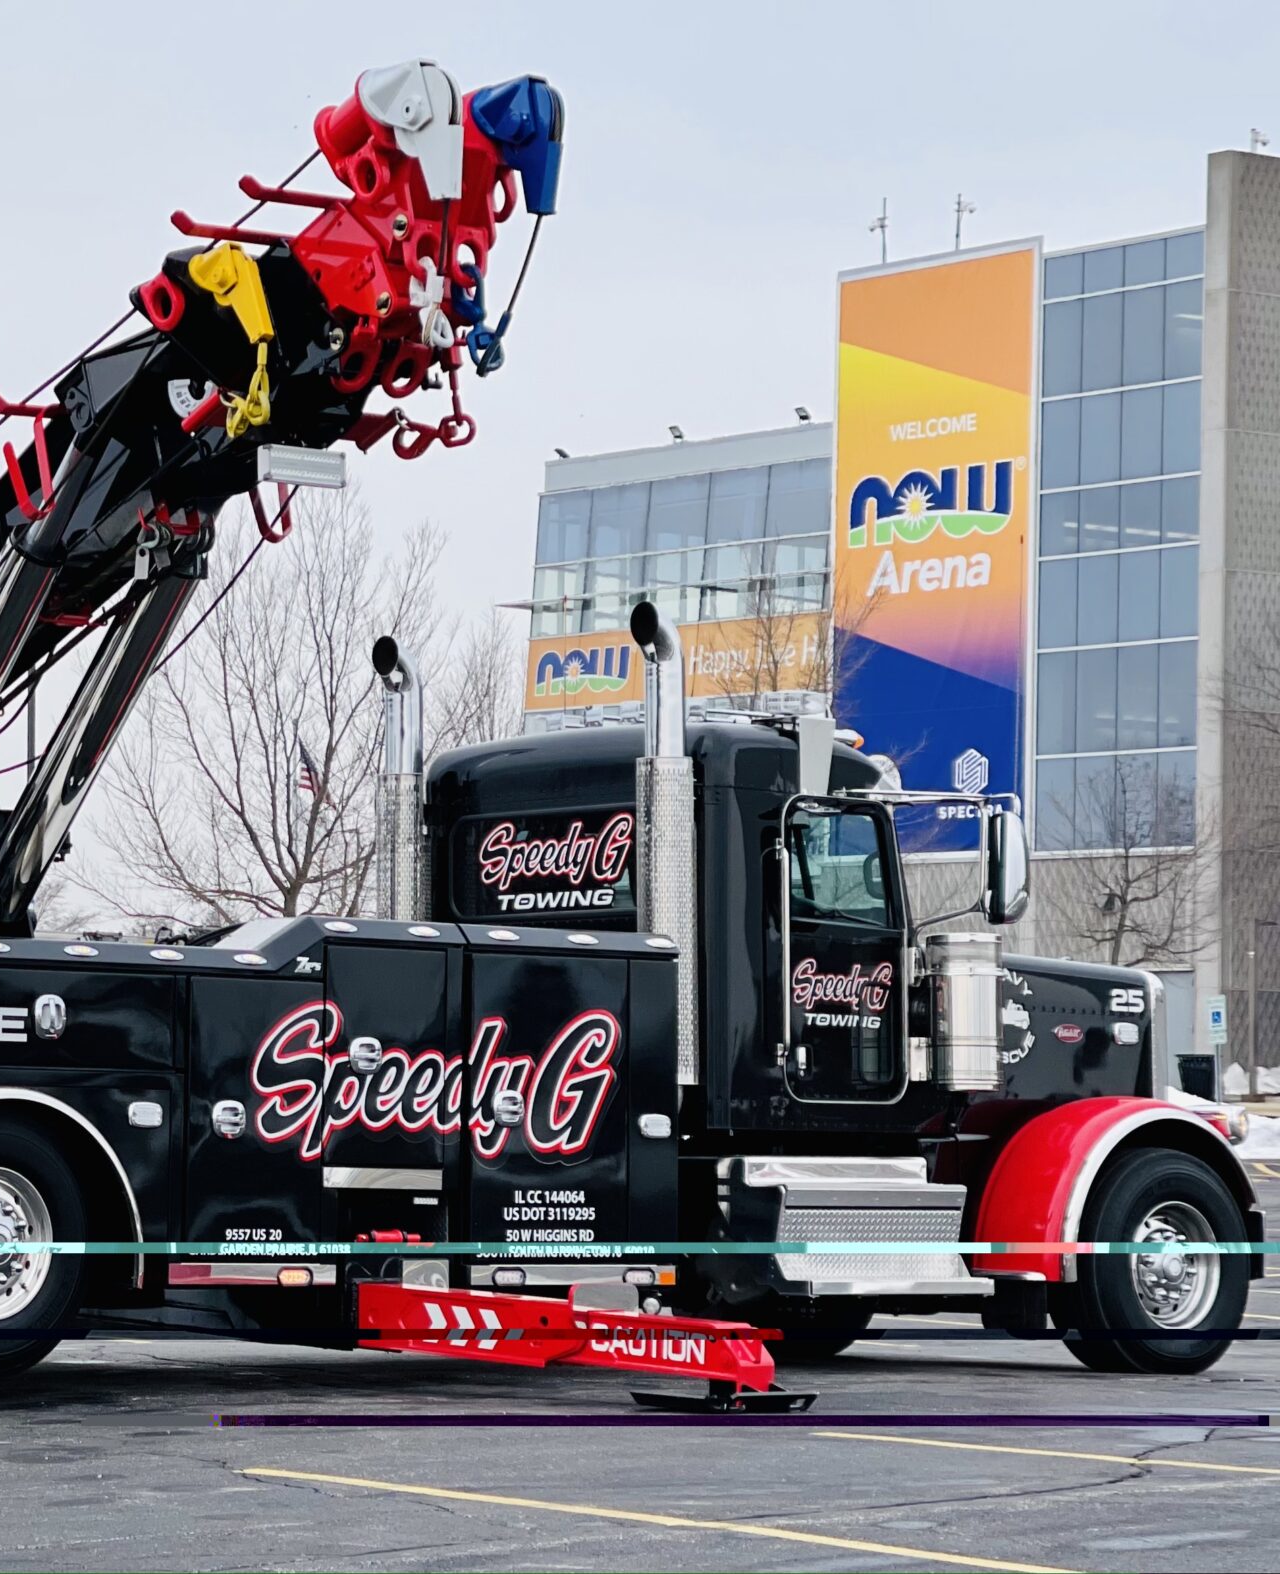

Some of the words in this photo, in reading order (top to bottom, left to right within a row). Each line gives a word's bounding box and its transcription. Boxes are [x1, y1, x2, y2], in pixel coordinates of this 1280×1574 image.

[890, 413, 977, 441] WELCOME
[866, 550, 991, 597] Arena
[479, 821, 595, 891] Speedy
[592, 812, 634, 882] G
[498, 889, 615, 911] TOWING
[792, 958, 869, 1010] Speedy
[867, 962, 893, 1011] G
[1111, 988, 1145, 1013] 25
[804, 1013, 882, 1029] TOWING
[250, 1000, 535, 1162] Speedy
[524, 1008, 622, 1156] G
[514, 1190, 525, 1204] IL
[526, 1190, 542, 1204] CC
[544, 1190, 586, 1204] 144064
[503, 1207, 520, 1221] US
[521, 1207, 546, 1221] DOT
[547, 1207, 596, 1221] 3119295
[225, 1229, 251, 1241] 9557
[252, 1229, 267, 1241] US
[269, 1229, 282, 1241] 20
[506, 1229, 520, 1242] 50
[520, 1230, 532, 1242] W
[533, 1229, 578, 1242] HIGGINS
[579, 1229, 595, 1242] RD
